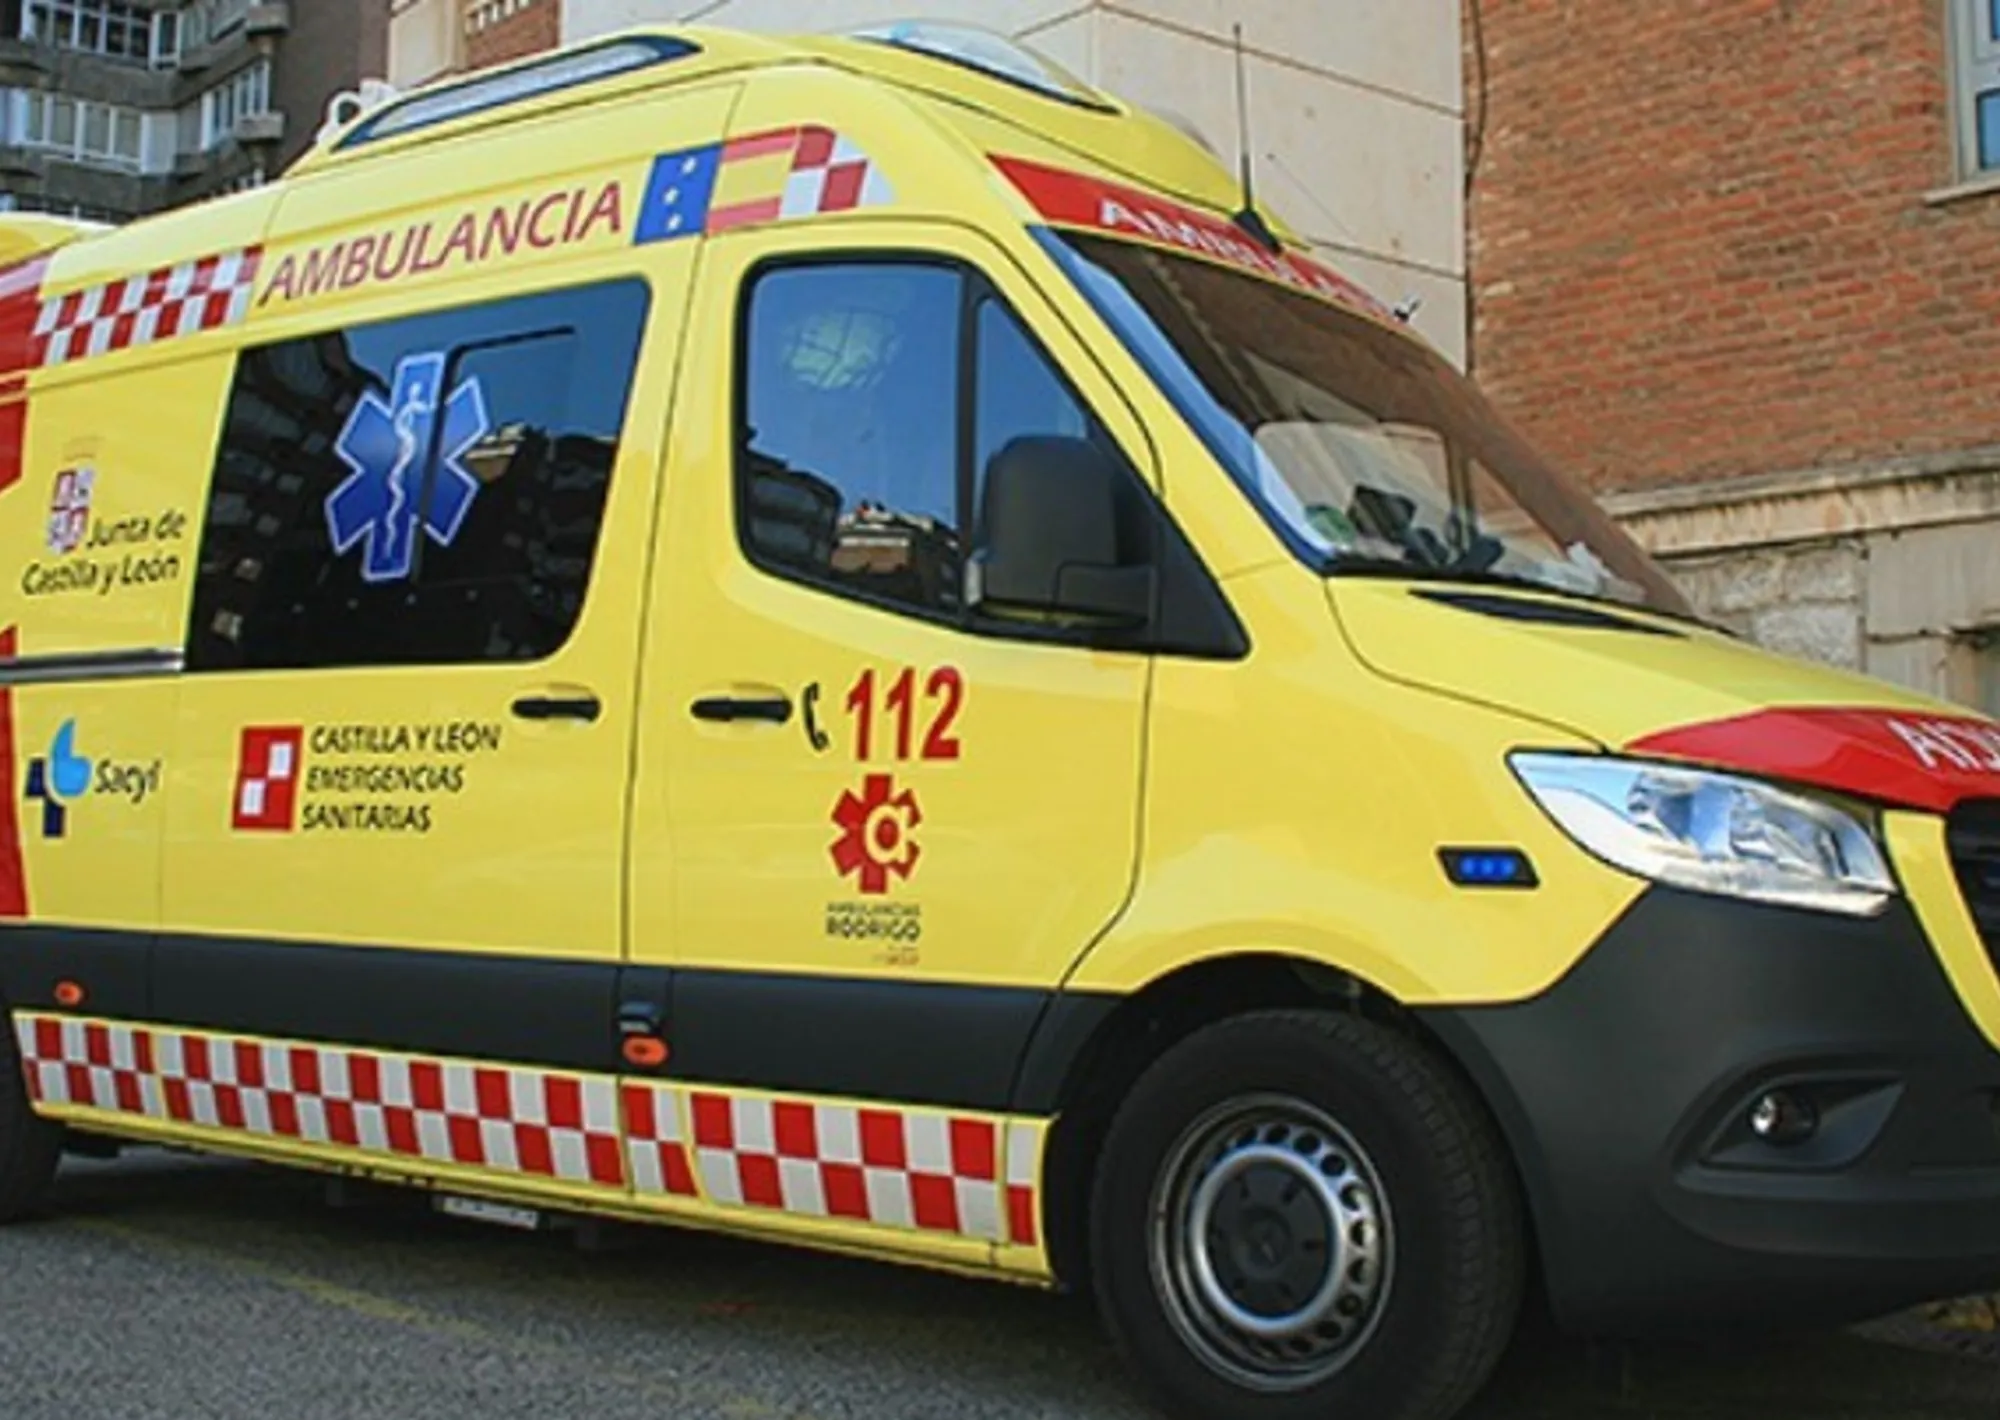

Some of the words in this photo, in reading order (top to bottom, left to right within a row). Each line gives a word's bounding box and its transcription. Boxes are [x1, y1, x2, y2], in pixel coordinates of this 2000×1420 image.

[258, 180, 622, 307] AMBULANCIA
[86, 516, 150, 549] Junta
[155, 509, 187, 540] de
[21, 557, 98, 595] Castilla
[98, 562, 117, 596] y
[119, 551, 181, 585] León
[845, 665, 964, 761] 112
[310, 723, 410, 753] CASTILLA
[412, 724, 432, 752] Y
[305, 764, 465, 793] EMERGENCIAS
[302, 804, 433, 833] SANITARIAS
